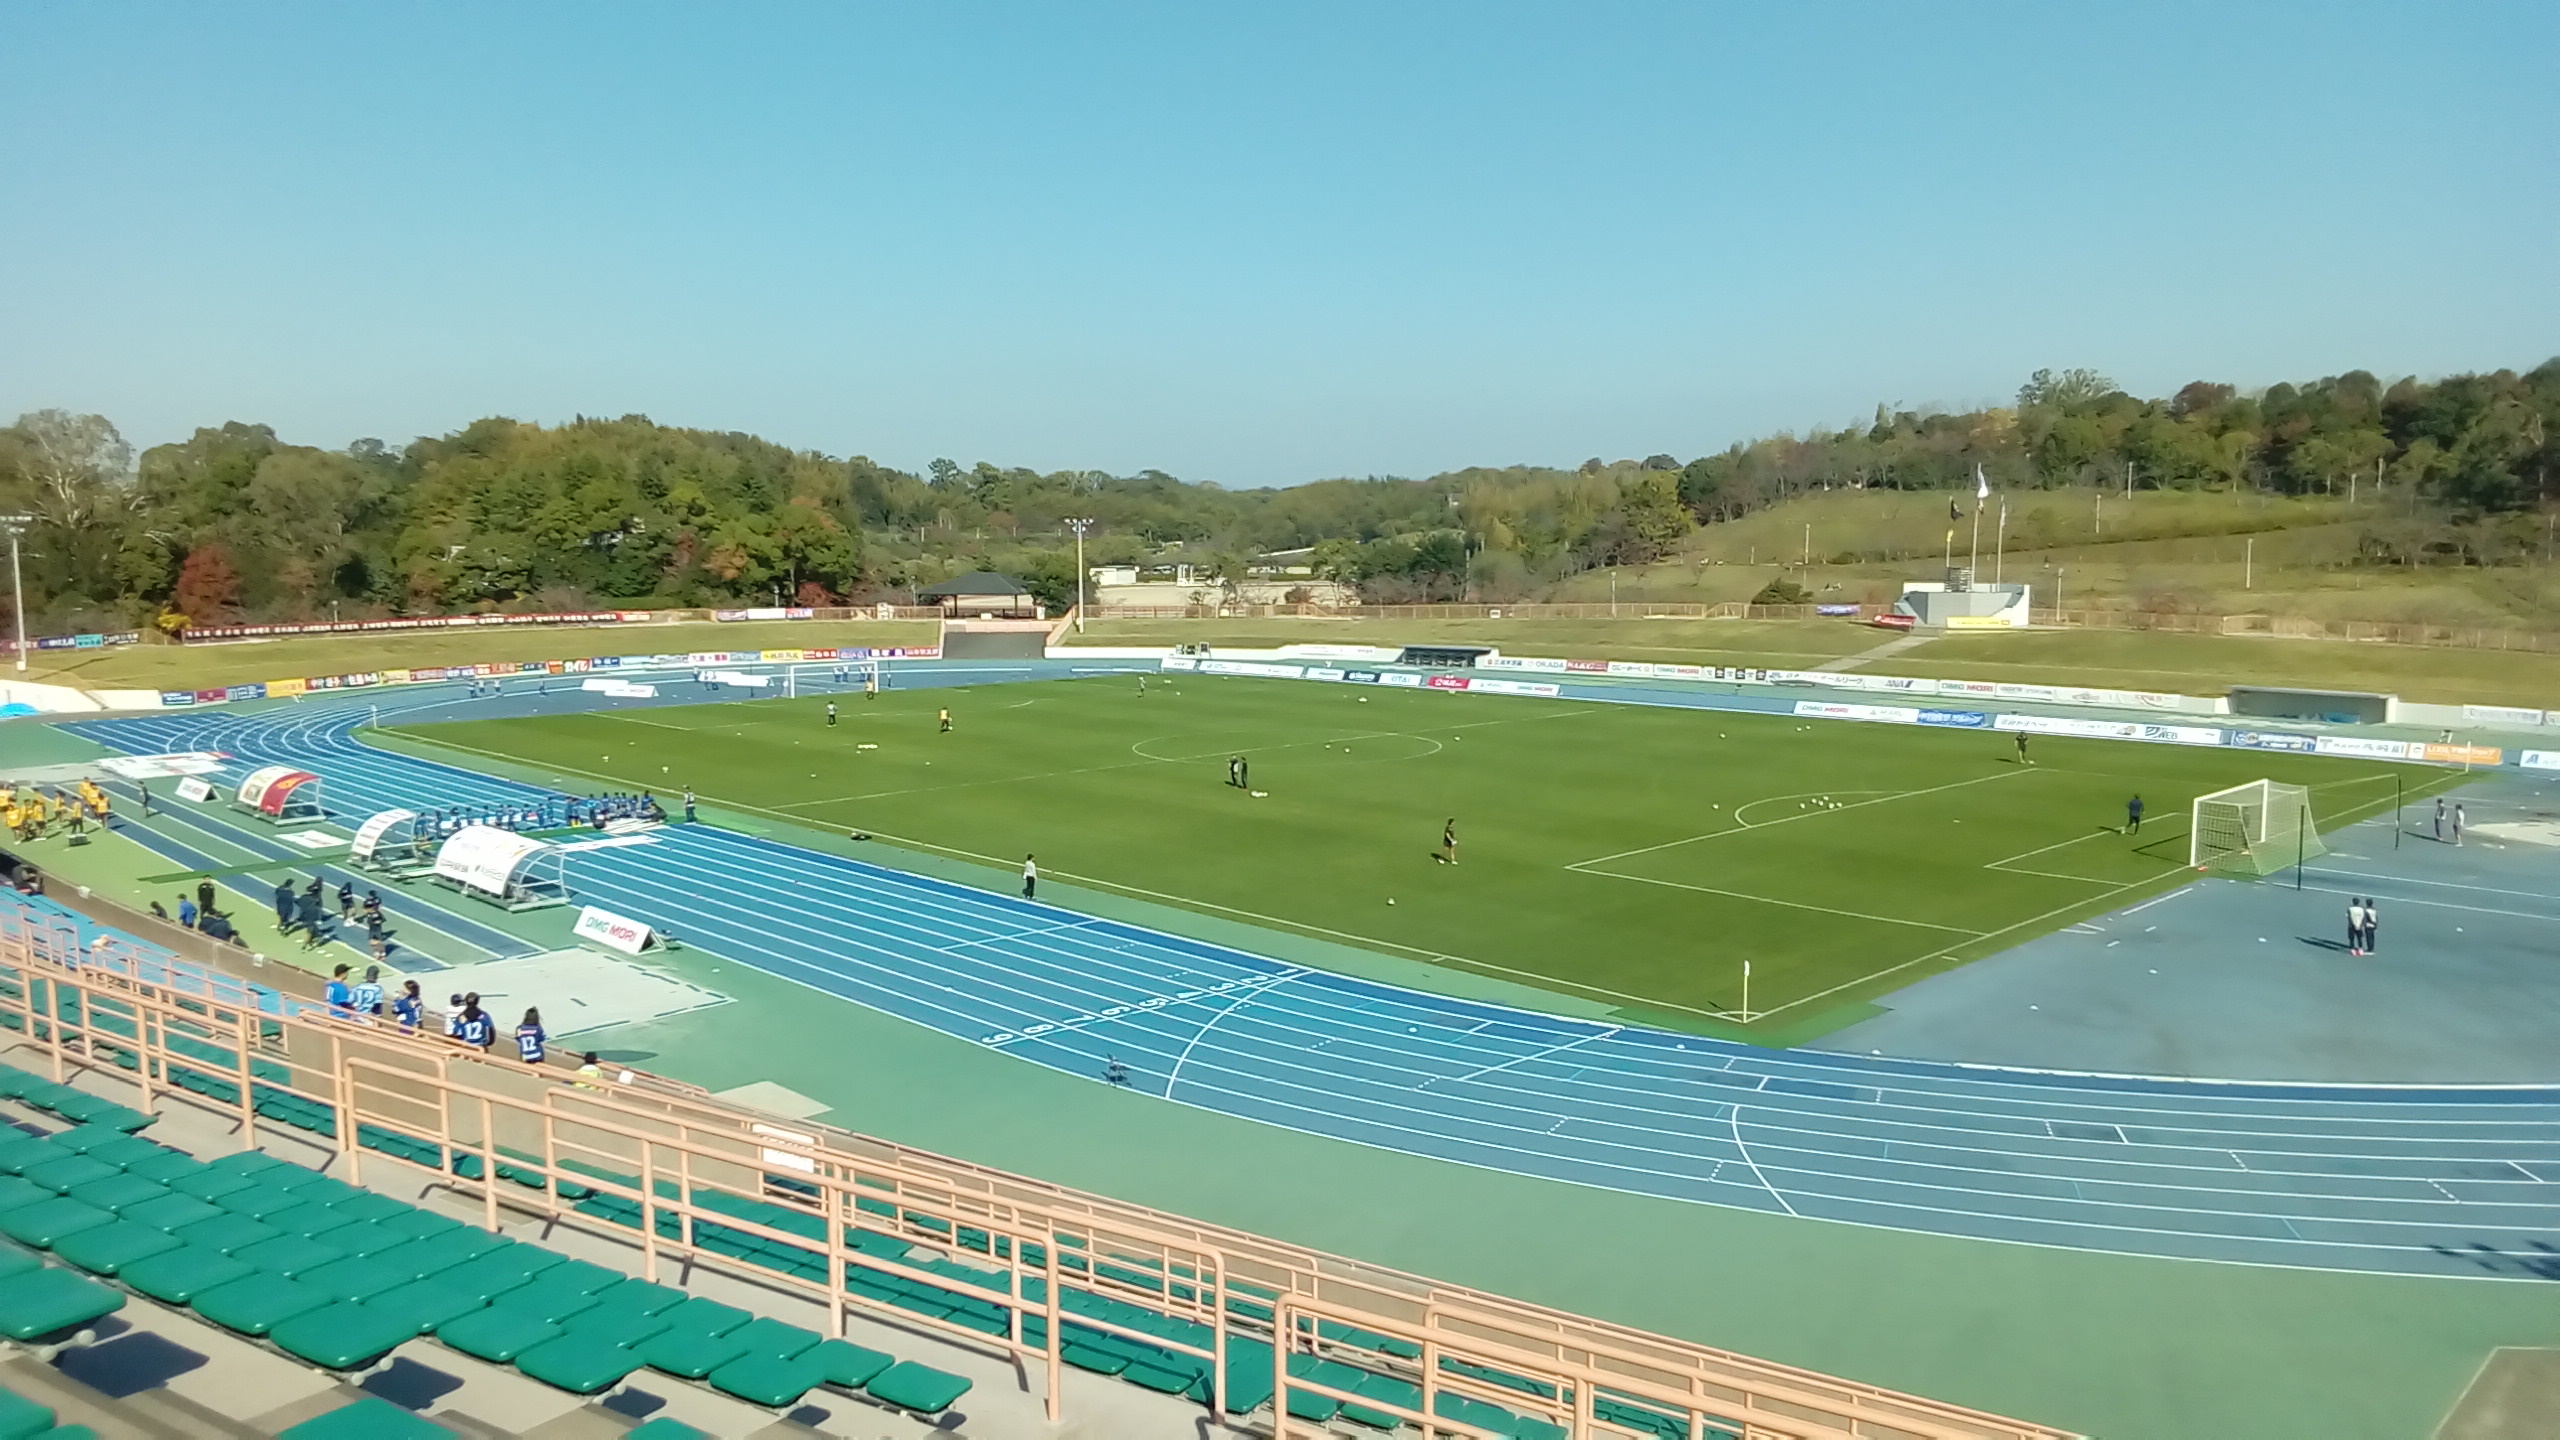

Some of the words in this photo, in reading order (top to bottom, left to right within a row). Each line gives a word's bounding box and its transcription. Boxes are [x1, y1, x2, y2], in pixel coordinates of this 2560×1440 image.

[1966, 683, 1994, 693] MORI
[586, 916, 610, 933] DMG
[609, 924, 638, 943] MORI
[356, 989, 376, 1004] 12
[464, 1020, 483, 1040] 12
[1022, 1024, 1055, 1034] 8
[520, 1036, 537, 1052] 12
[981, 1033, 1014, 1044] 9
